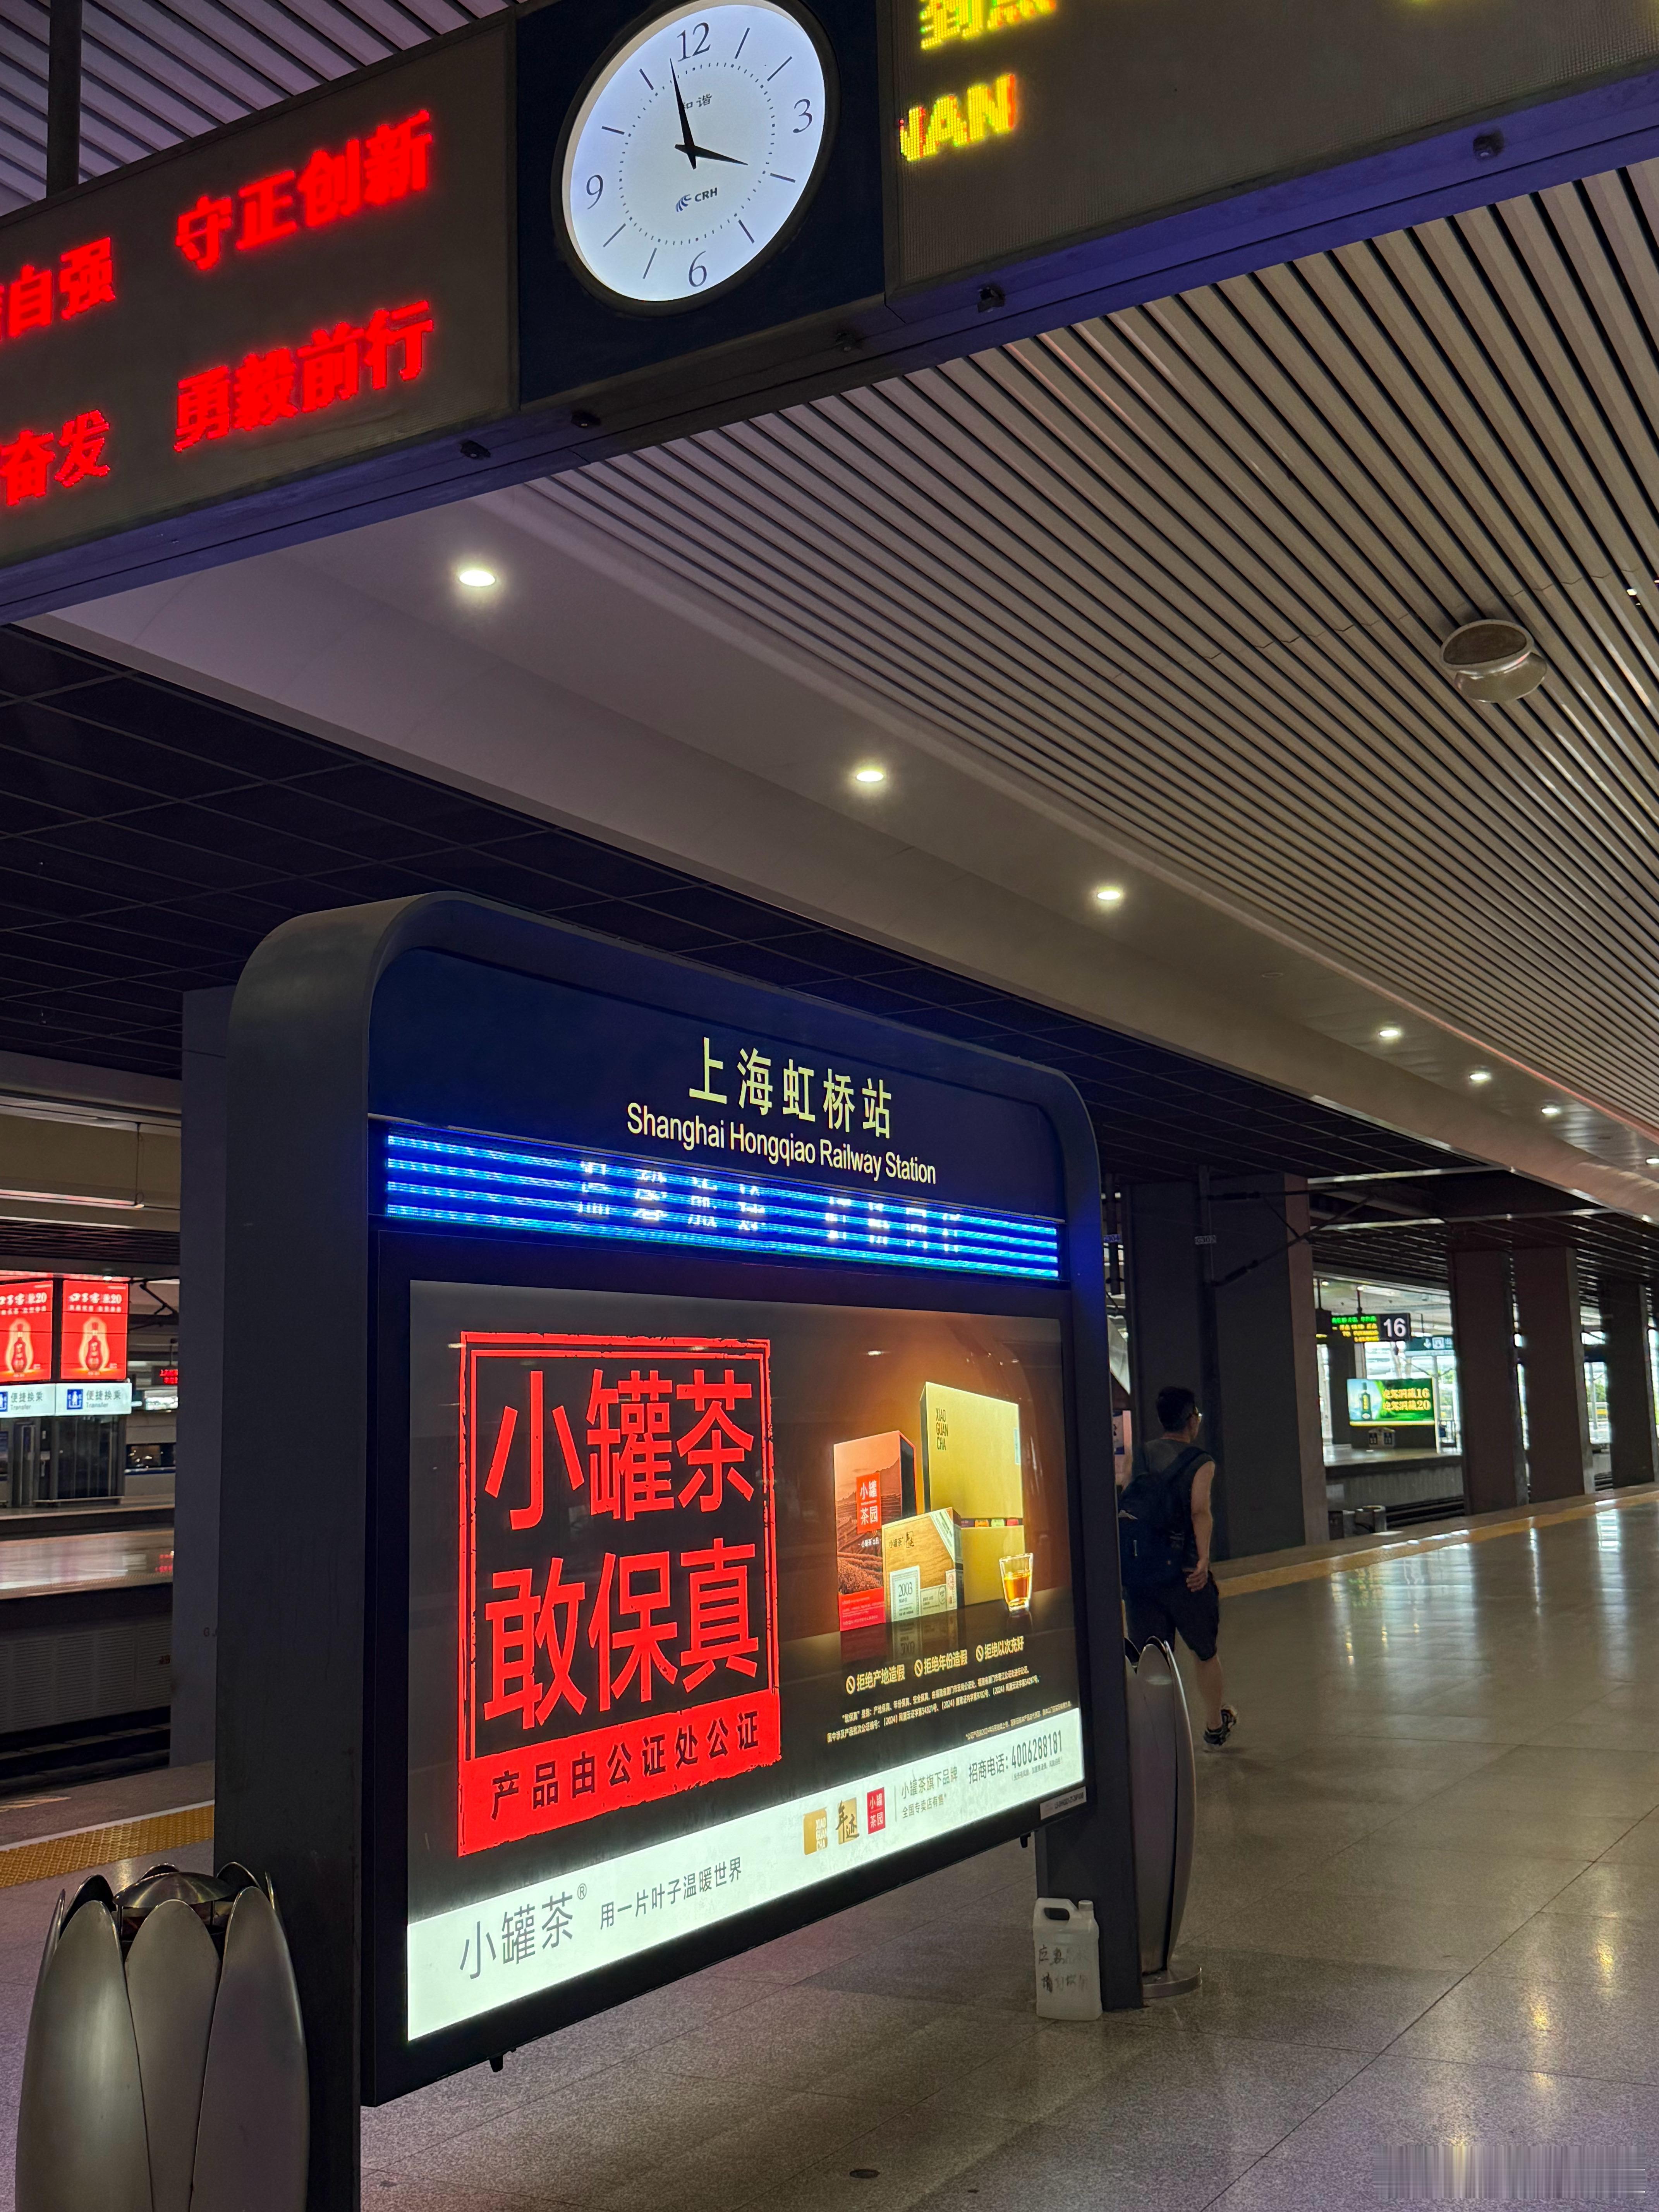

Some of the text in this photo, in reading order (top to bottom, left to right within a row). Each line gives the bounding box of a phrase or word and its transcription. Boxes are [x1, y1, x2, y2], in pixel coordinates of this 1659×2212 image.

[676, 22, 711, 62] 12
[793, 98, 813, 133] 3
[586, 174, 604, 210] 9
[694, 187, 718, 202] CRH
[0, 109, 433, 341] 自强 守正创新
[688, 250, 708, 287] 6
[173, 301, 434, 452] 勇毅前行
[689, 1037, 892, 1139] 上海虹桥站
[627, 1102, 936, 1184] Shanghai Hongqiao Railway Station
[1383, 1317, 1407, 1337] 16
[86, 1389, 121, 1401] 便捷换乘
[936, 1408, 946, 1422] XIAO
[936, 1422, 948, 1437] GUAN
[484, 1368, 754, 1531] 小罐茶
[936, 1436, 946, 1450] CHA
[859, 1480, 877, 1500] 小罐
[860, 1505, 878, 1525] 茶园
[898, 1582, 913, 1597] 2003
[483, 1537, 760, 1731] 敢保真
[857, 1635, 1024, 1692] 拒绝产地造假 拒绝年份造假 拒绝以次充好
[490, 1710, 760, 1821] 产品由公证处公证
[901, 1766, 958, 1800] 小罐茶旗下品牌
[869, 1793, 883, 1810] 小罐
[869, 1811, 883, 1829] 茶园
[599, 1856, 742, 1931] 用一片叶子温暖世界
[459, 1891, 574, 1980] 小罐茶
